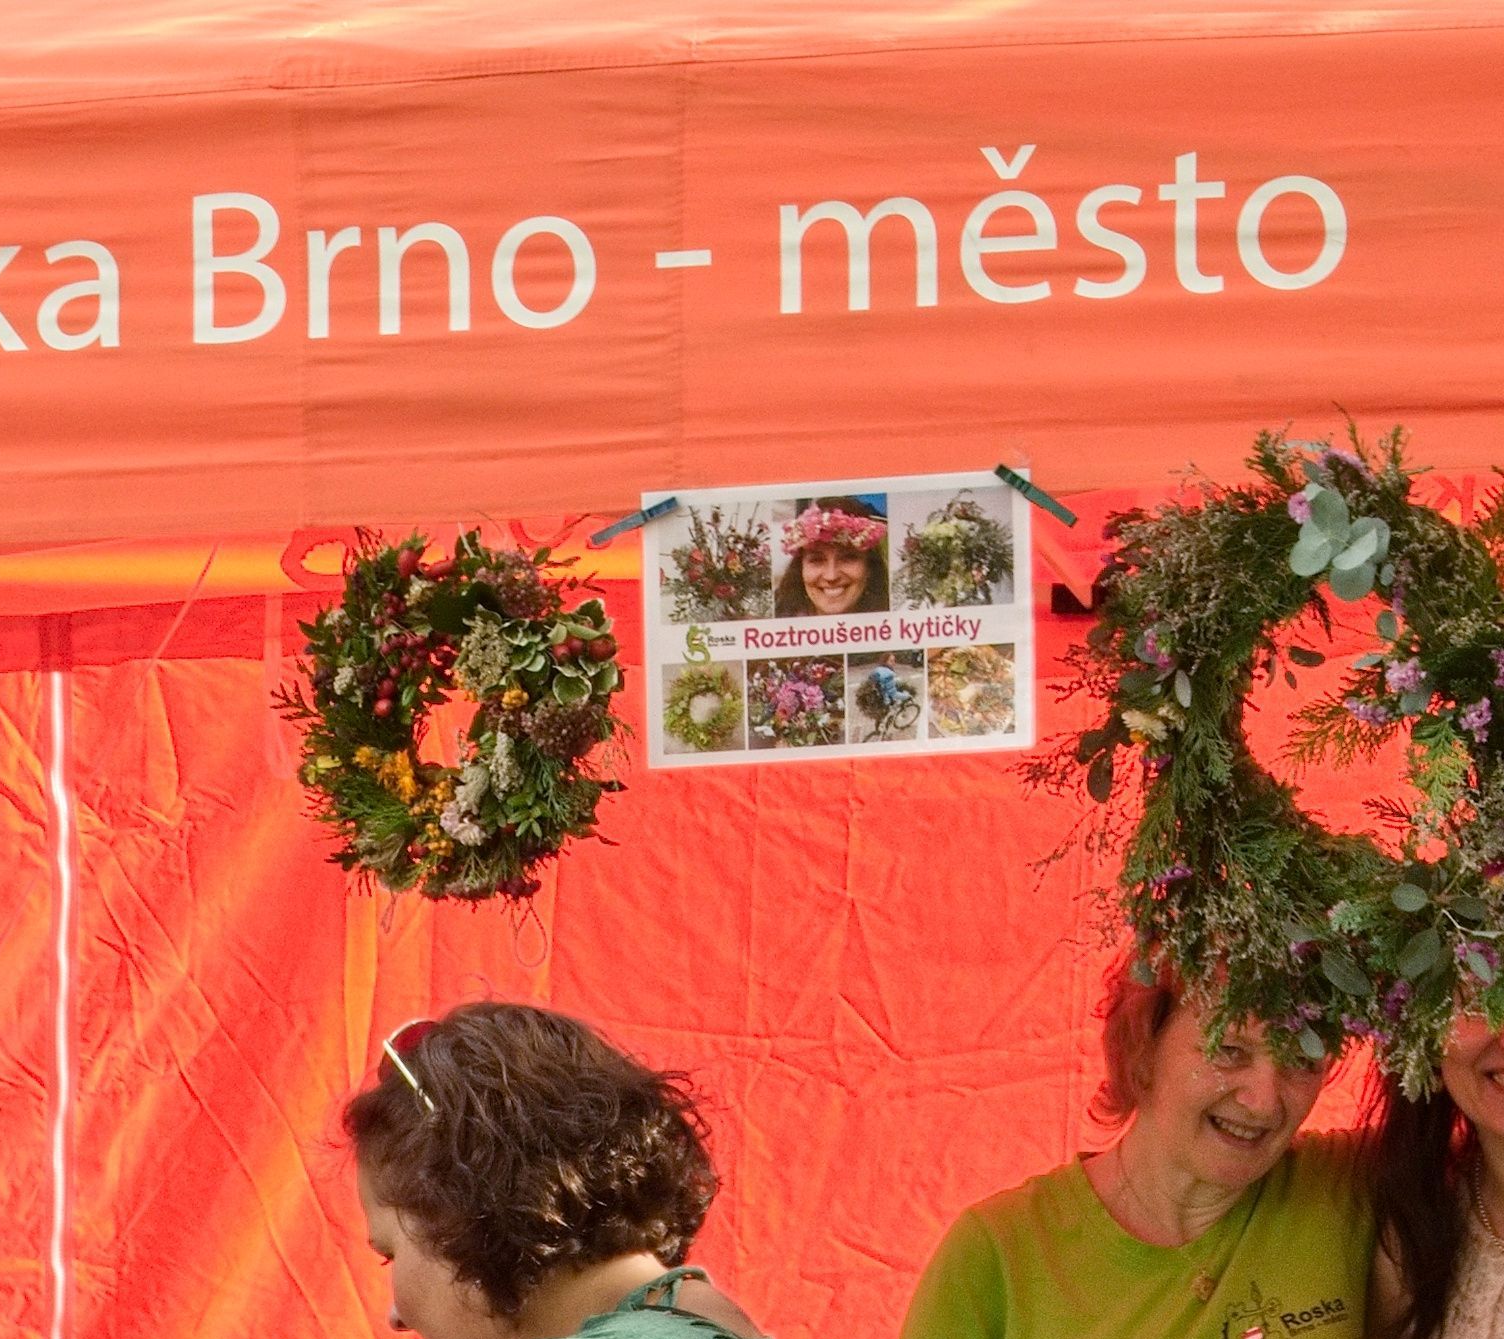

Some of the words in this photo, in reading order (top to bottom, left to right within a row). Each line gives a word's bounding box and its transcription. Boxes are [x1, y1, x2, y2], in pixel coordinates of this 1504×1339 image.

[192, 190, 598, 345] Brno
[655, 246, 712, 270] -
[777, 142, 1350, 316] město
[743, 620, 892, 650] Roztroušené
[899, 614, 982, 645] kytičky
[1279, 1299, 1346, 1330] Roska
